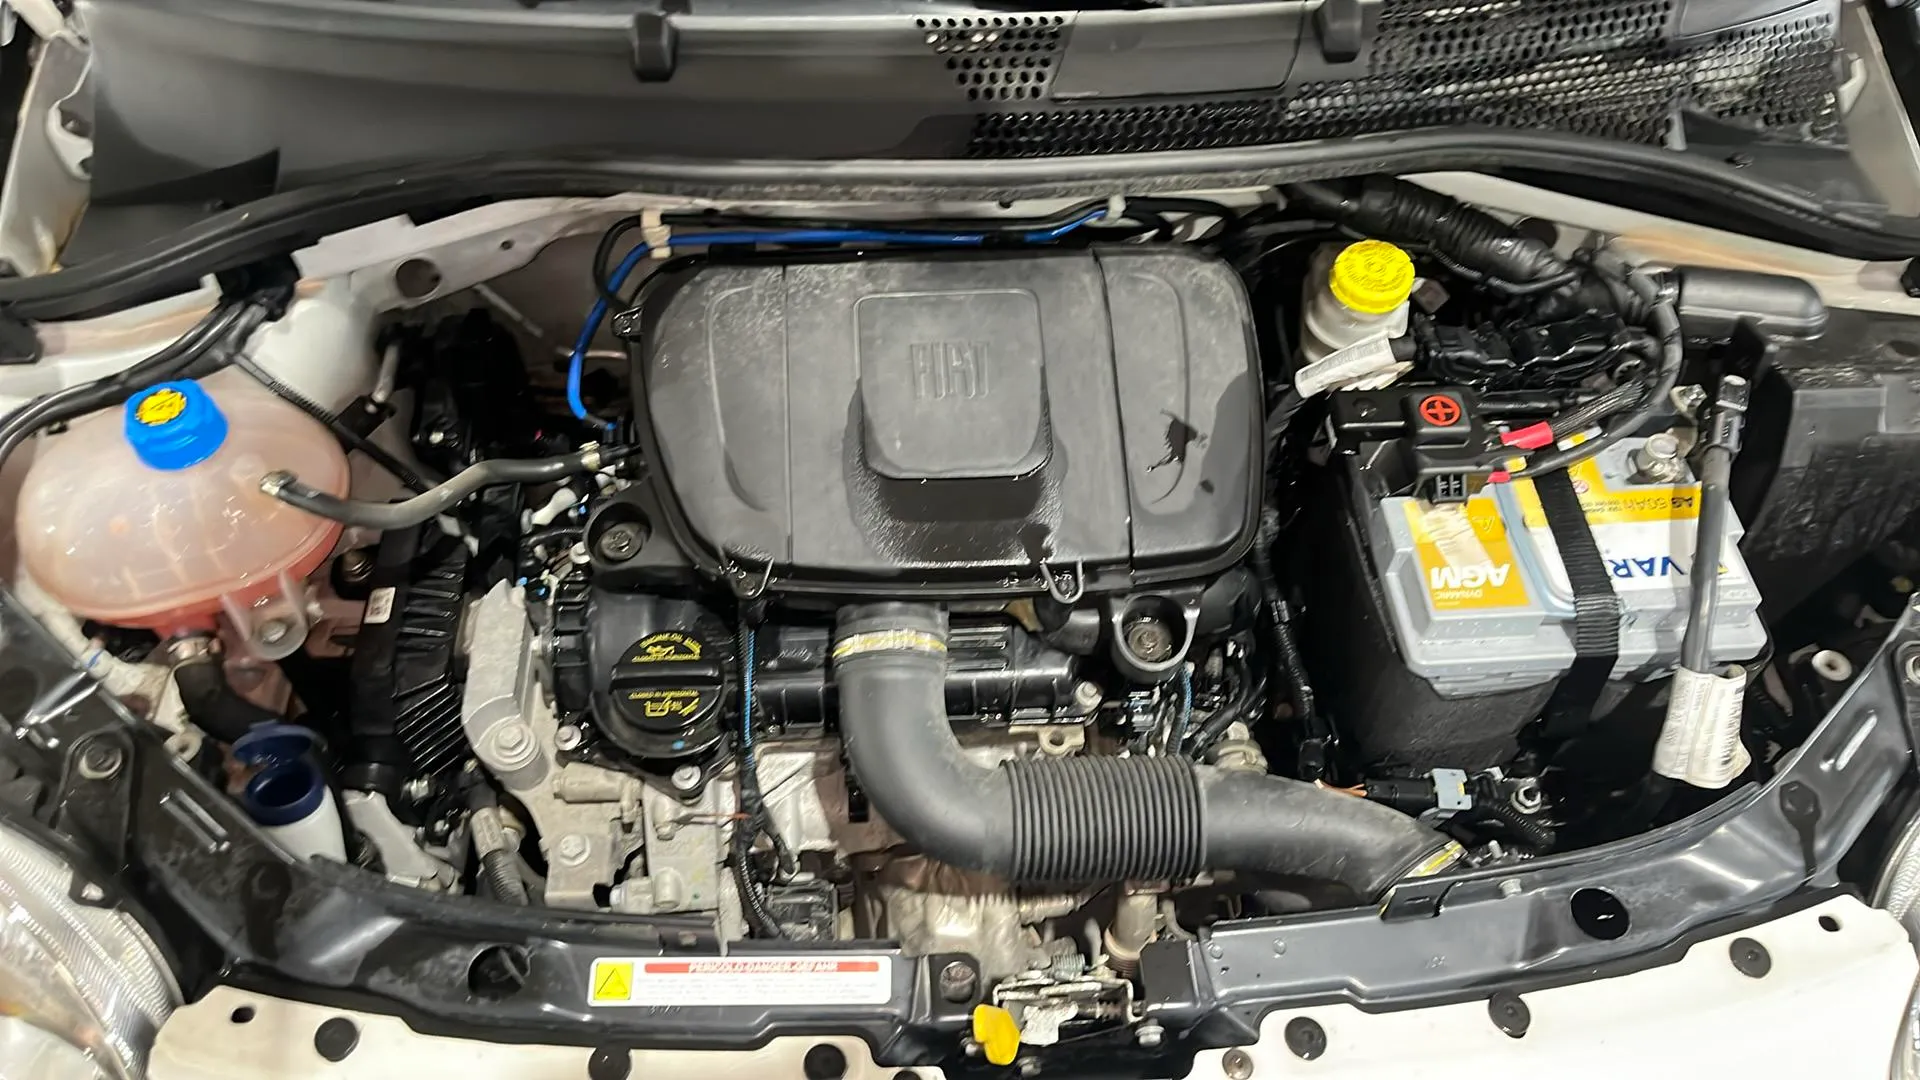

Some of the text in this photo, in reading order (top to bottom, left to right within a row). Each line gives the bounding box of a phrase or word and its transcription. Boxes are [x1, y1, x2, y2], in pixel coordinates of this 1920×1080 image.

[910, 341, 990, 400] FIAT
[1431, 562, 1511, 590] AGM
[1607, 555, 1688, 578] VAR
[1434, 588, 1483, 600] DYNAMIC
